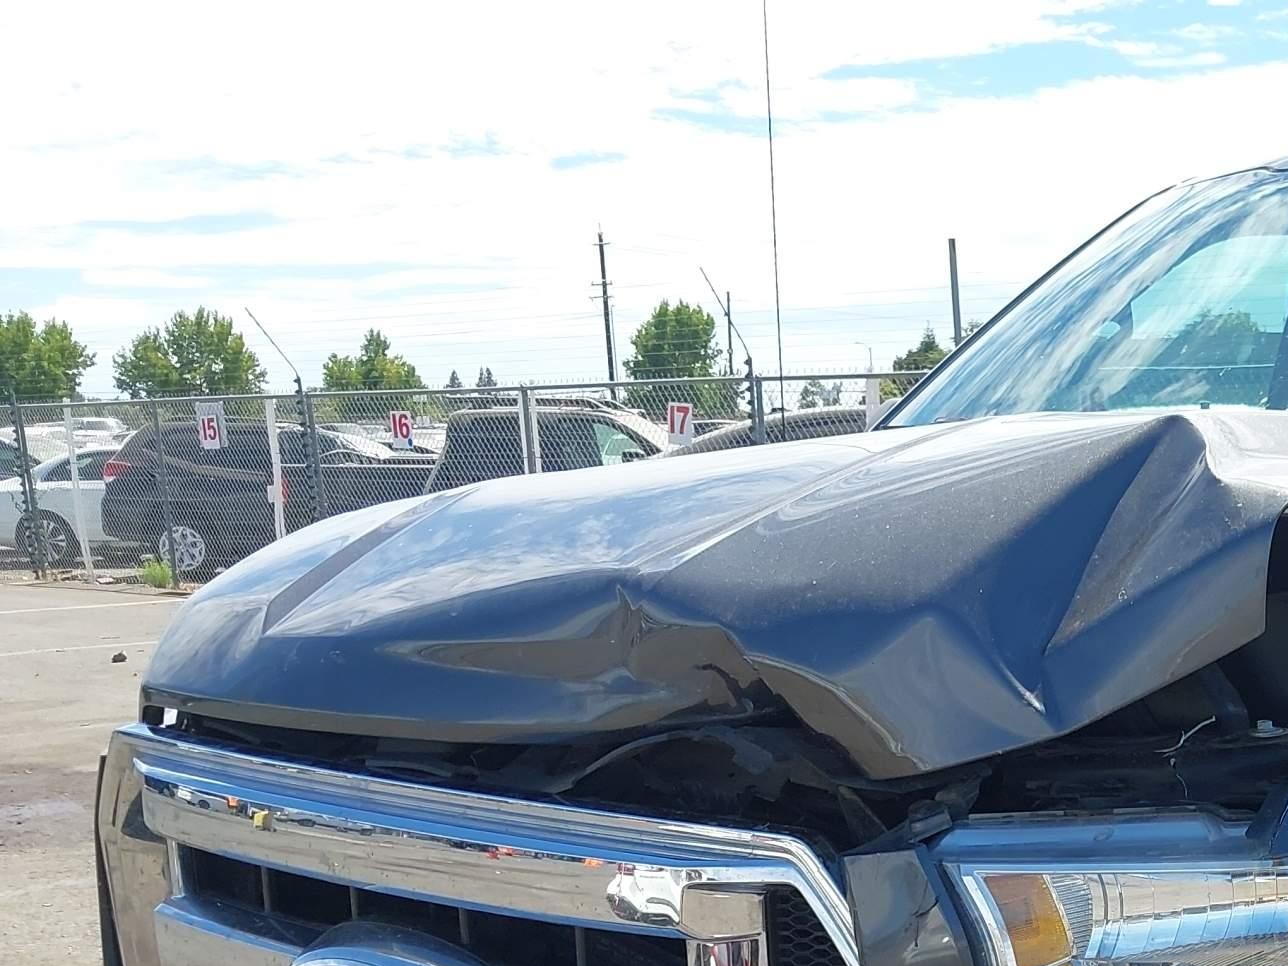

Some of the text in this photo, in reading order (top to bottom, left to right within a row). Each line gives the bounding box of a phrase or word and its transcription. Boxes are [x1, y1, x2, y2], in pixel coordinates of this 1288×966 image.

[201, 417, 217, 441] 15
[391, 413, 410, 439] 16
[670, 405, 690, 434] 17
